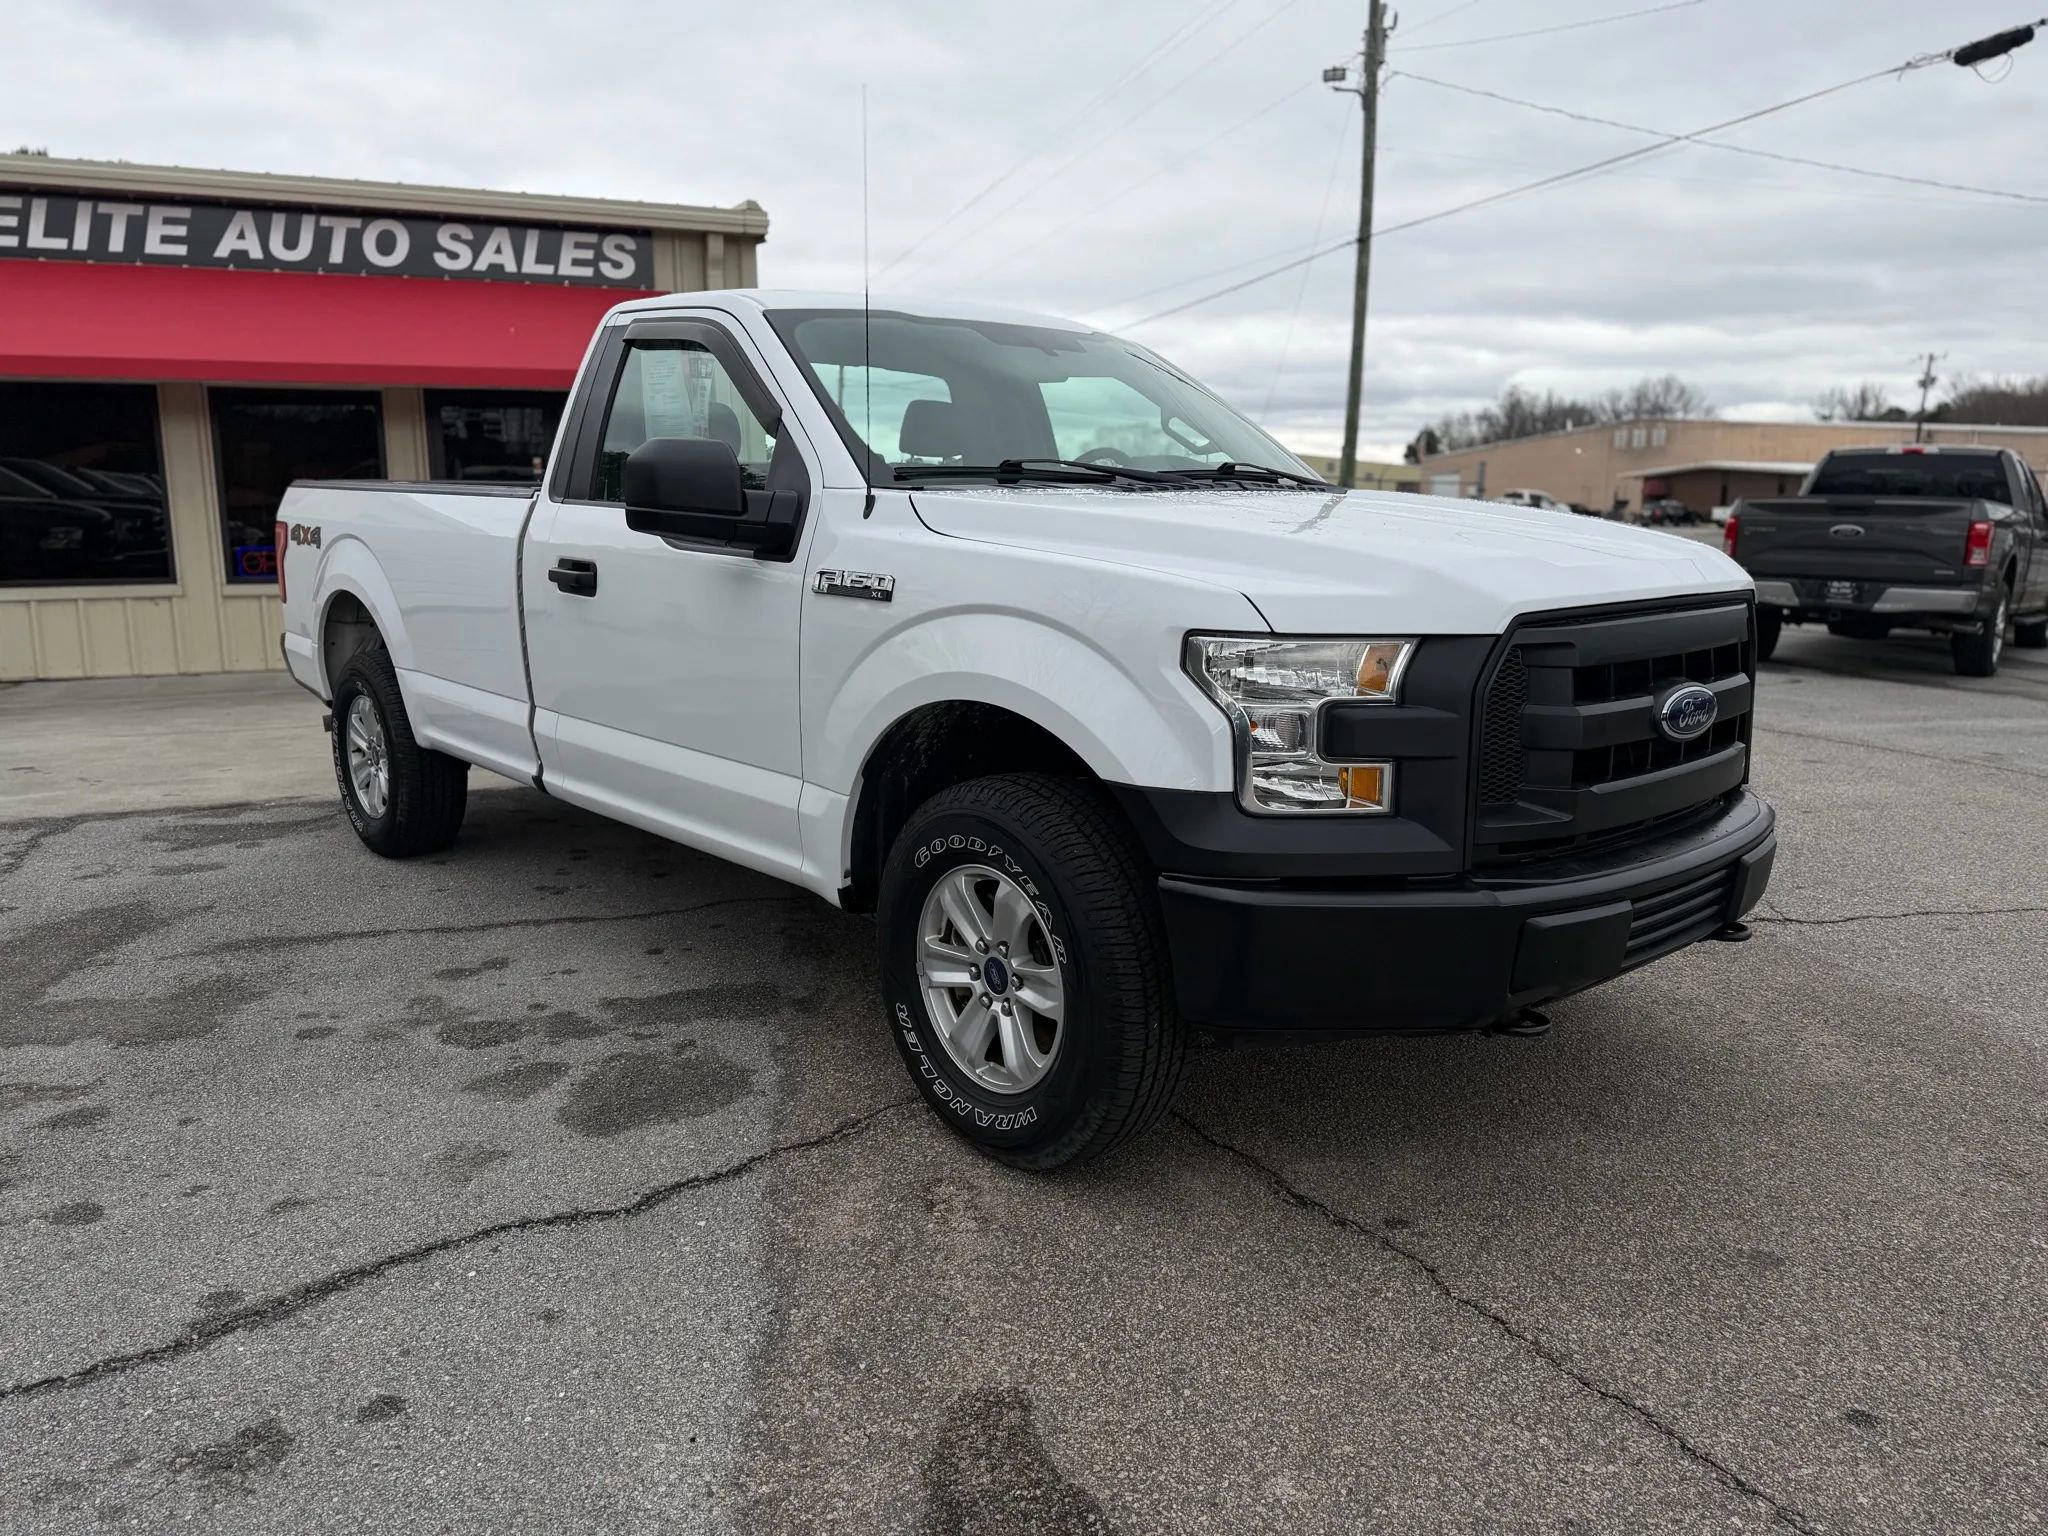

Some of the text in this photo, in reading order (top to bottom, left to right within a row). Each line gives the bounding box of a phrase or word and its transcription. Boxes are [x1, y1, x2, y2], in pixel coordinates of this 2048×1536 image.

[212, 210, 411, 269] AUTO
[432, 222, 638, 280] SALES
[871, 590, 884, 599] XL
[1679, 697, 1709, 728] Ford
[914, 834, 1068, 965] GOODYEAR
[895, 1002, 1038, 1130] WRANGLER
